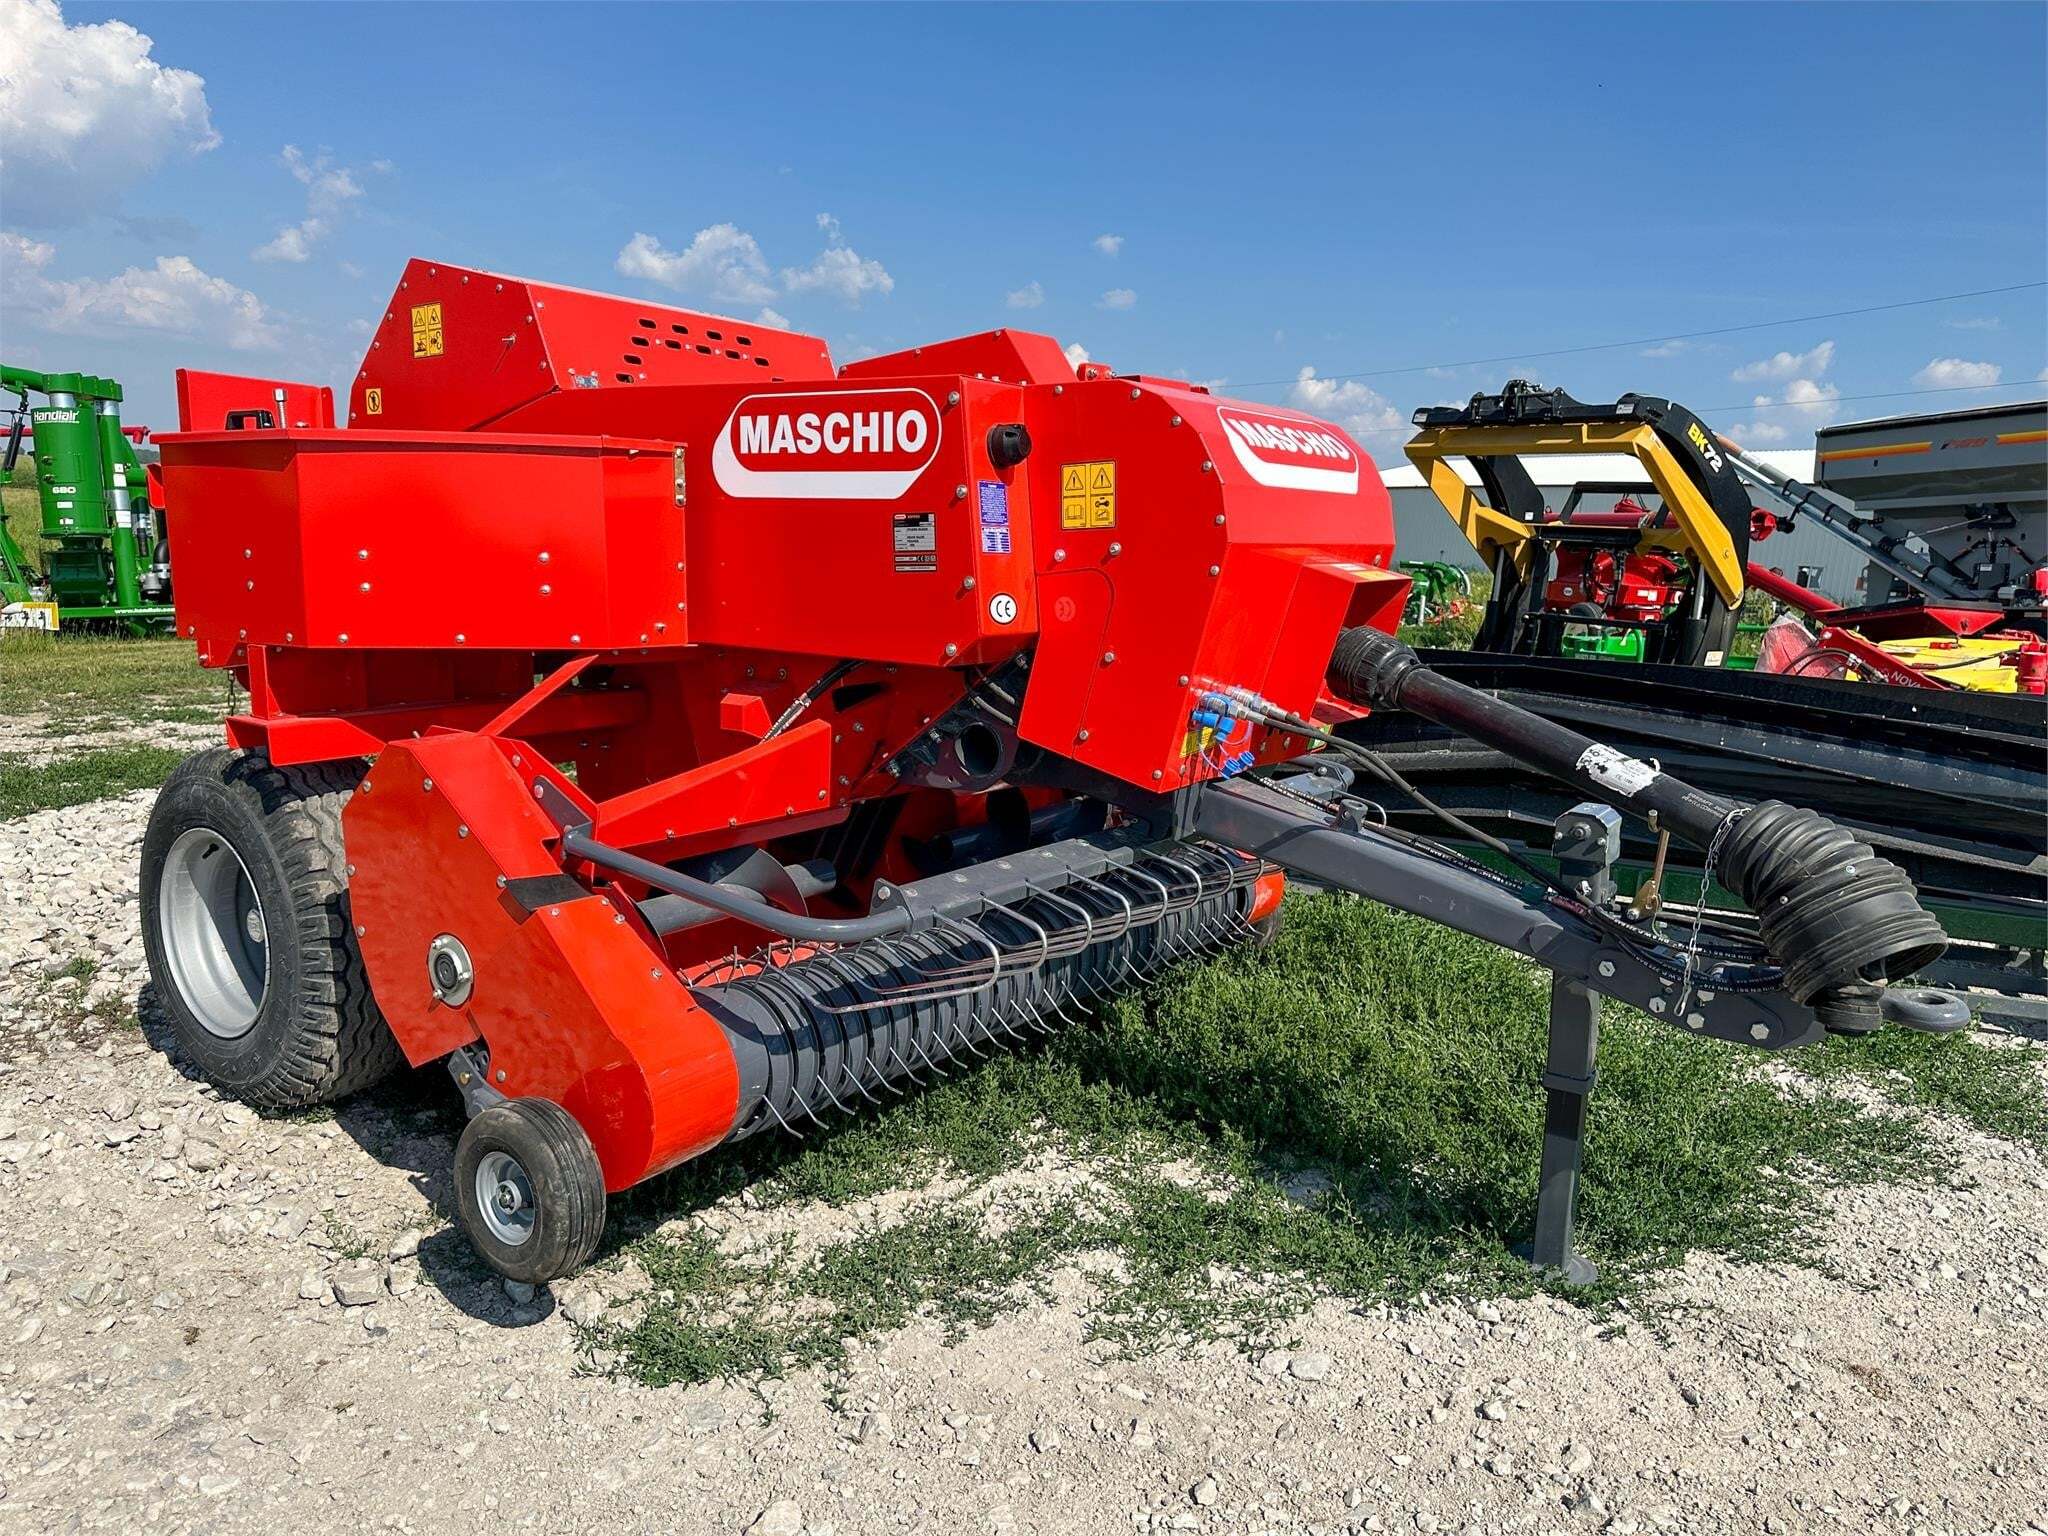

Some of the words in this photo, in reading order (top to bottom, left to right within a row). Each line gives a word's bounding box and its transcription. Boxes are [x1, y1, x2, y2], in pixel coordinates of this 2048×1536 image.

[739, 410, 927, 454] MASCHIO
[1226, 418, 1350, 460] MASCHIO
[1687, 422, 1723, 473] BK72
[996, 600, 1011, 617] CE
